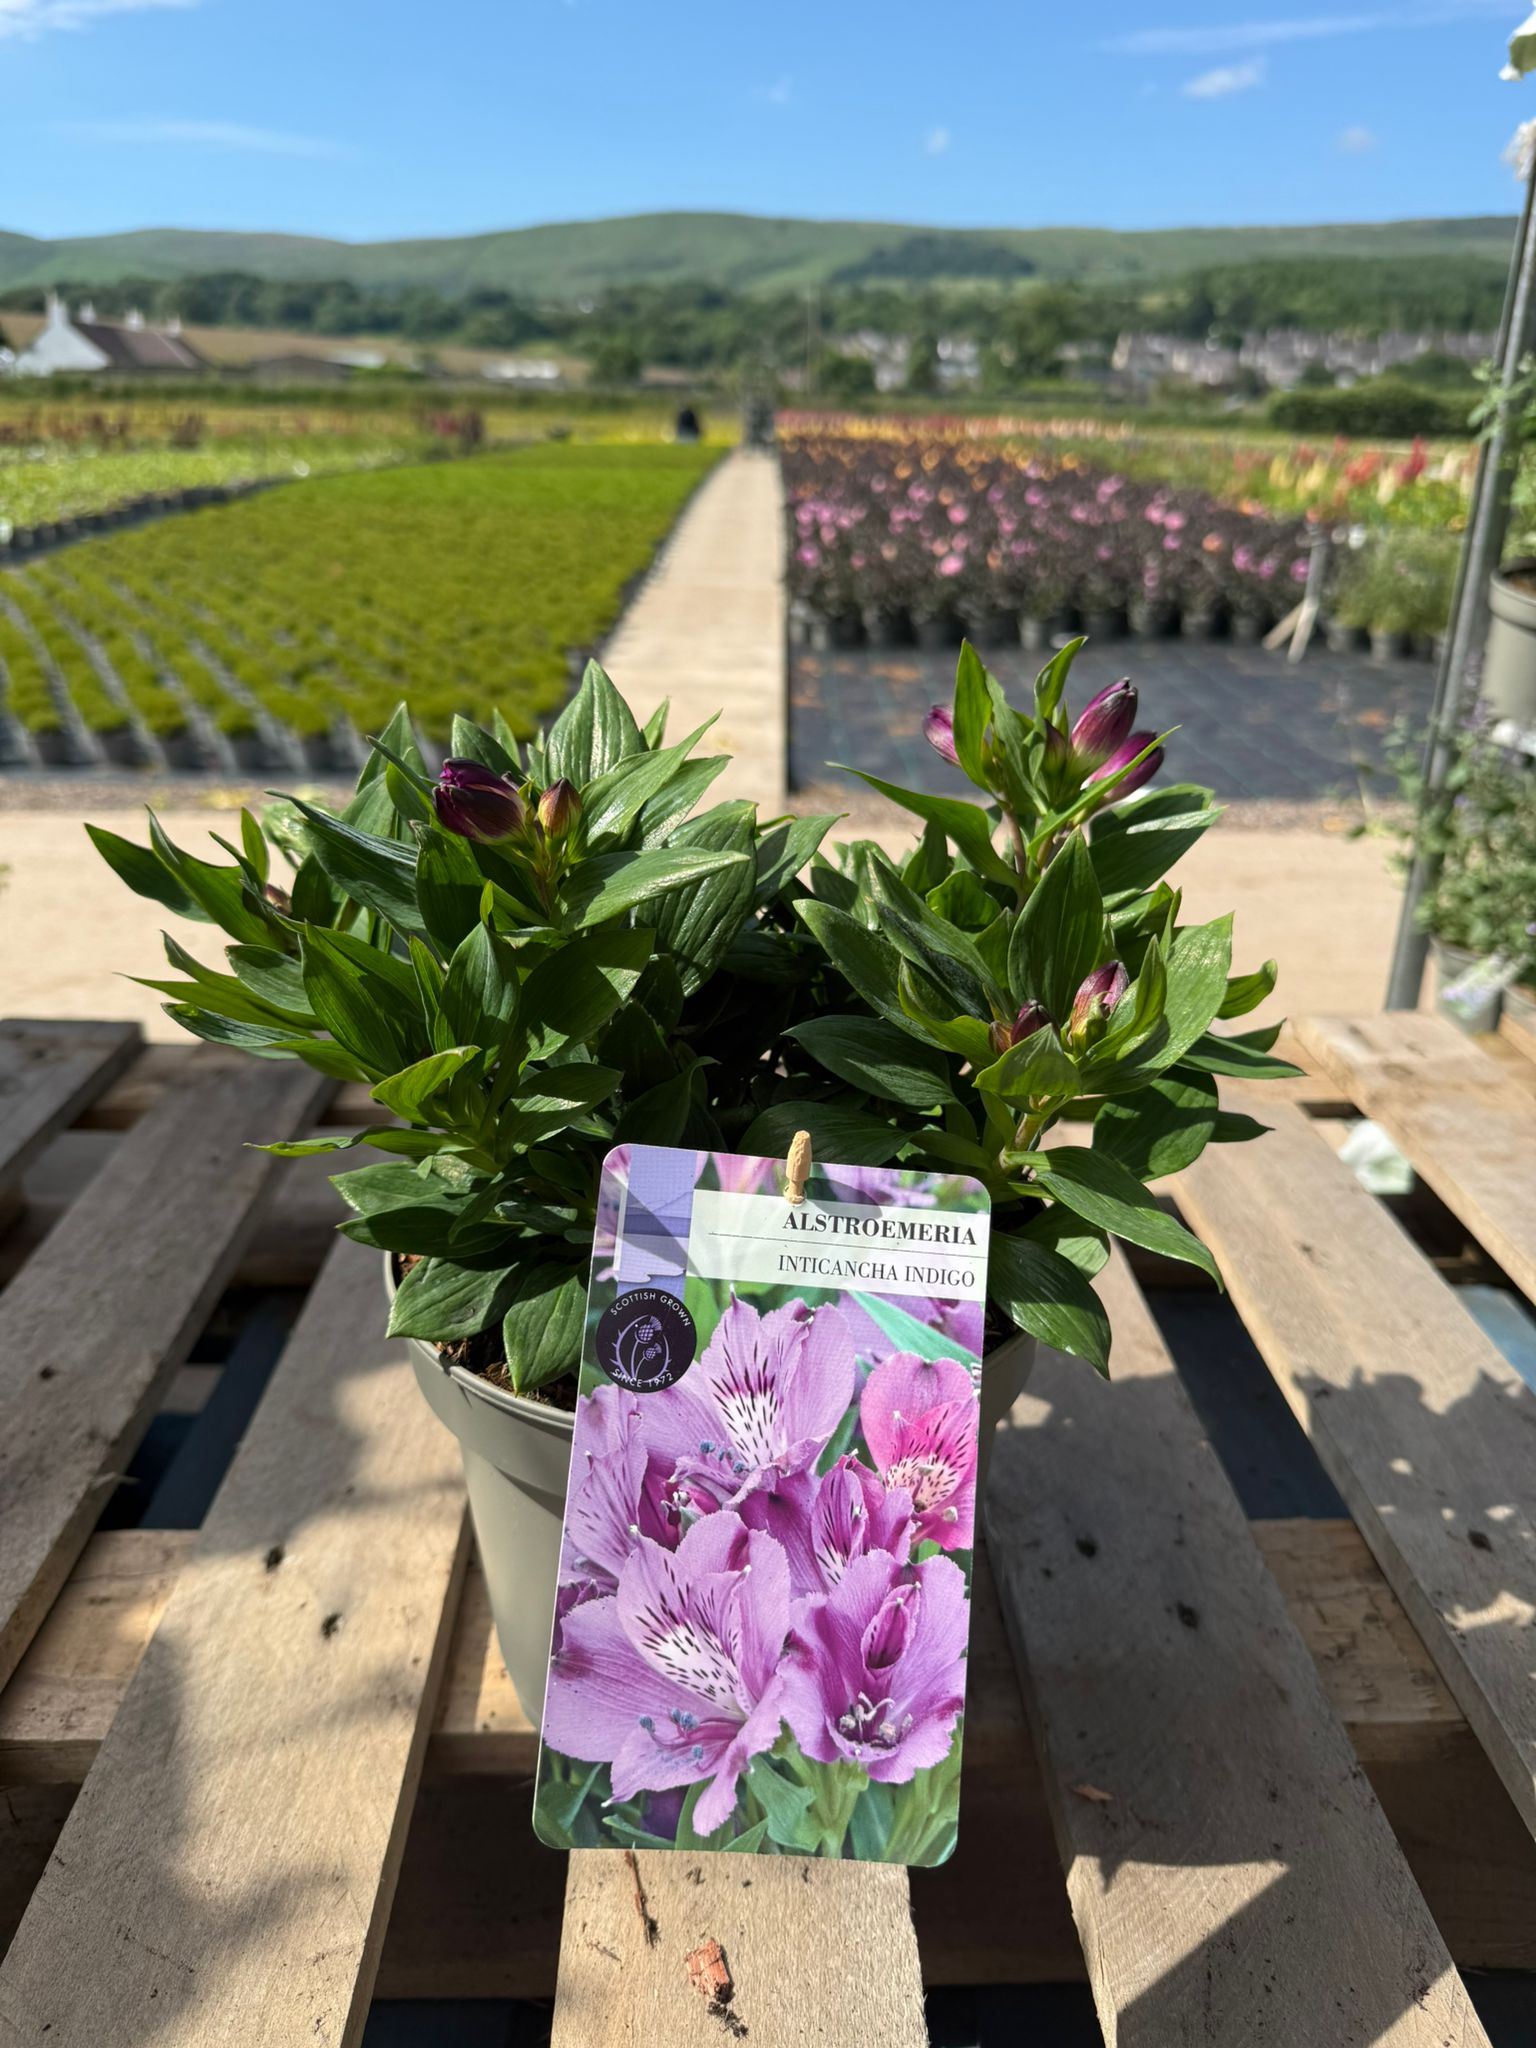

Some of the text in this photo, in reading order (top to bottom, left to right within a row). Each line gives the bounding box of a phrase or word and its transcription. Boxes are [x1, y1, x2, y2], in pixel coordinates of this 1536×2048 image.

[783, 1211, 977, 1246] ALSTROEMERIA
[779, 1254, 975, 1288] INTICANCHA INDIGO
[611, 1292, 691, 1326] SCOTTISH GROWN
[612, 1368, 673, 1387] SINCE 1972
